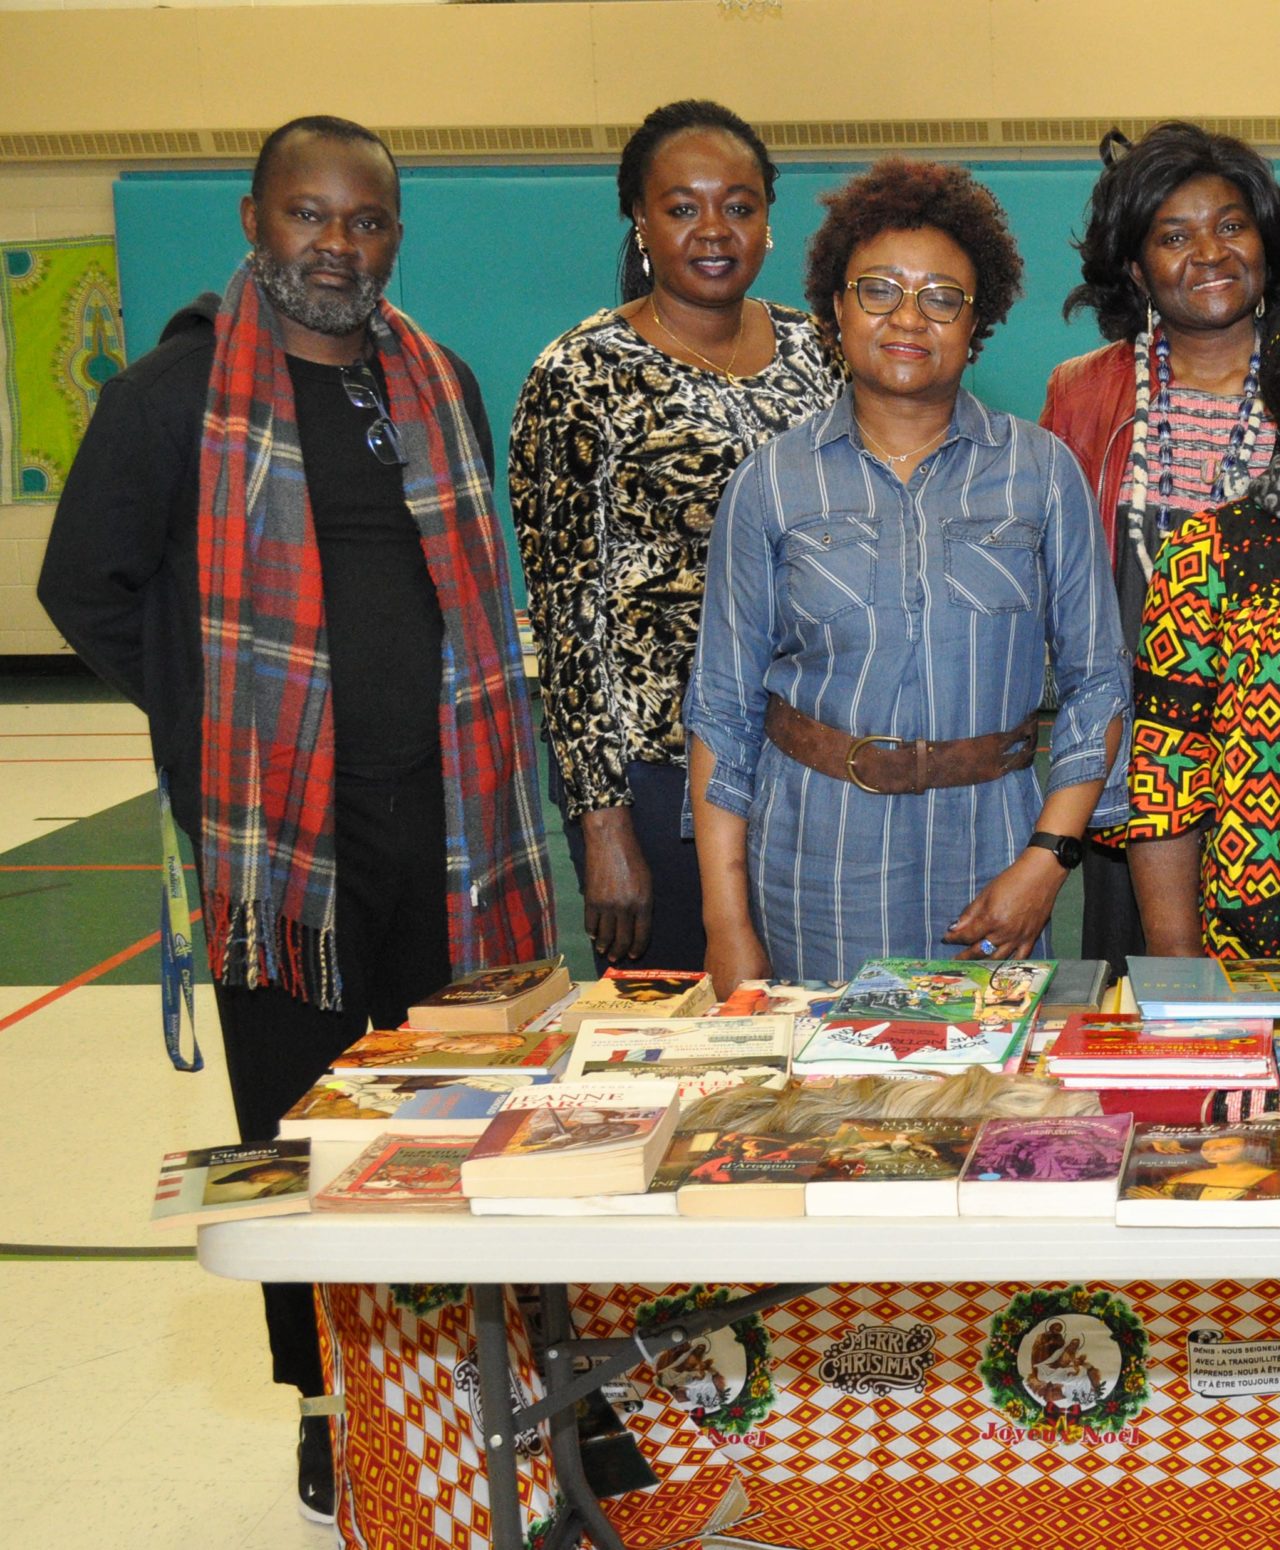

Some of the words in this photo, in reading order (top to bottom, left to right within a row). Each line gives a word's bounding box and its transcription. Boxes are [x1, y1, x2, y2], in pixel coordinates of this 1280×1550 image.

[508, 1093, 625, 1103] JEANNE
[1148, 1123, 1198, 1133] Anne
[1200, 1123, 1222, 1132] de
[721, 1162, 797, 1170] d'Artagnan
[849, 1331, 913, 1352] MERRY
[1222, 1346, 1243, 1355] NOUS
[818, 1350, 926, 1383] CHRISTMAS
[1195, 1358, 1215, 1366] AVEC
[1216, 1358, 1227, 1366] LA
[1193, 1368, 1233, 1377] APPRENDS
[1237, 1367, 1259, 1376] NOUS
[1216, 1378, 1236, 1388] ÊTRE
[1238, 1377, 1280, 1387] TOUJOURS
[705, 1426, 768, 1448] Noël
[980, 1420, 1071, 1446] Joyeux
[1081, 1425, 1142, 1446] Noël
